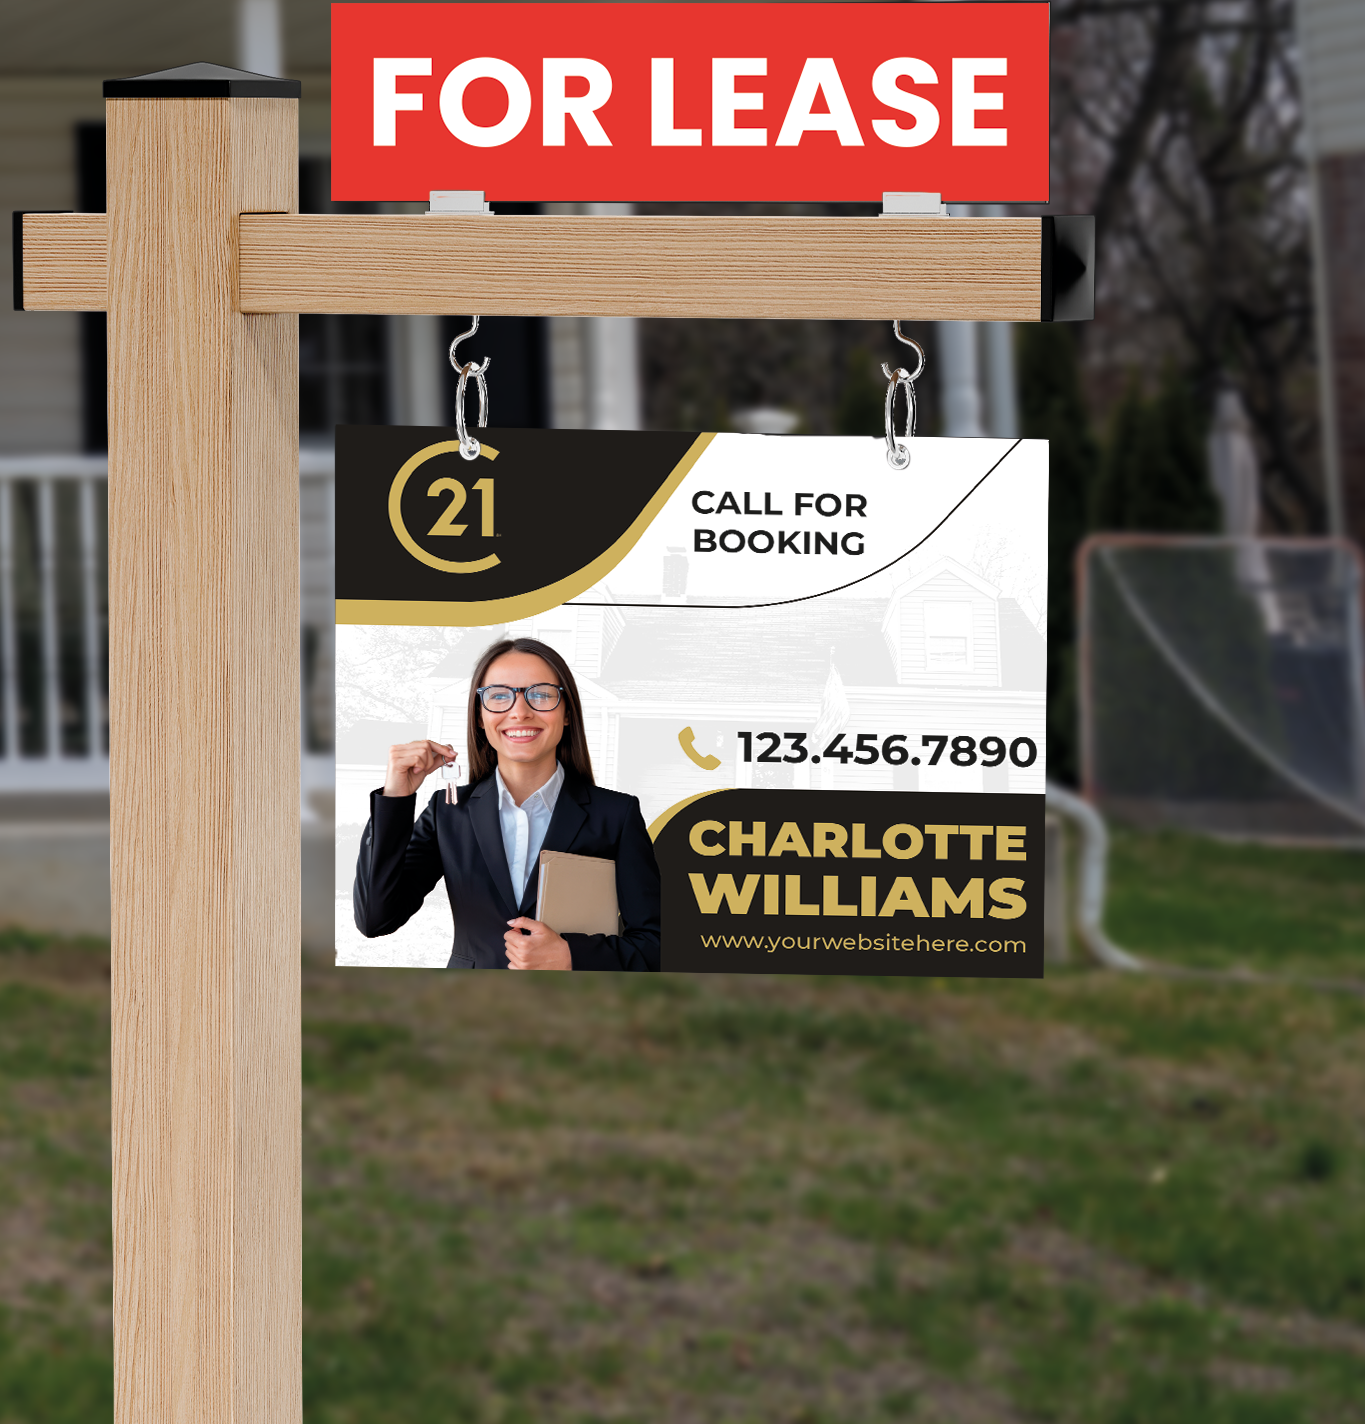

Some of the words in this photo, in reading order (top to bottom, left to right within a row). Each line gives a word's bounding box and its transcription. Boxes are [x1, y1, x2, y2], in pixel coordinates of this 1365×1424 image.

[373, 56, 614, 148] FOR
[651, 56, 1008, 148] LEASE
[692, 491, 783, 516] CALL
[795, 493, 867, 518] FOR
[694, 529, 865, 556] BOOKING
[738, 732, 1038, 768] 123.456.7890
[689, 820, 1027, 862] CHARLOTTE
[688, 873, 1027, 920] WILLIAMS
[700, 933, 1027, 954] www.yourwebsitehere.com
